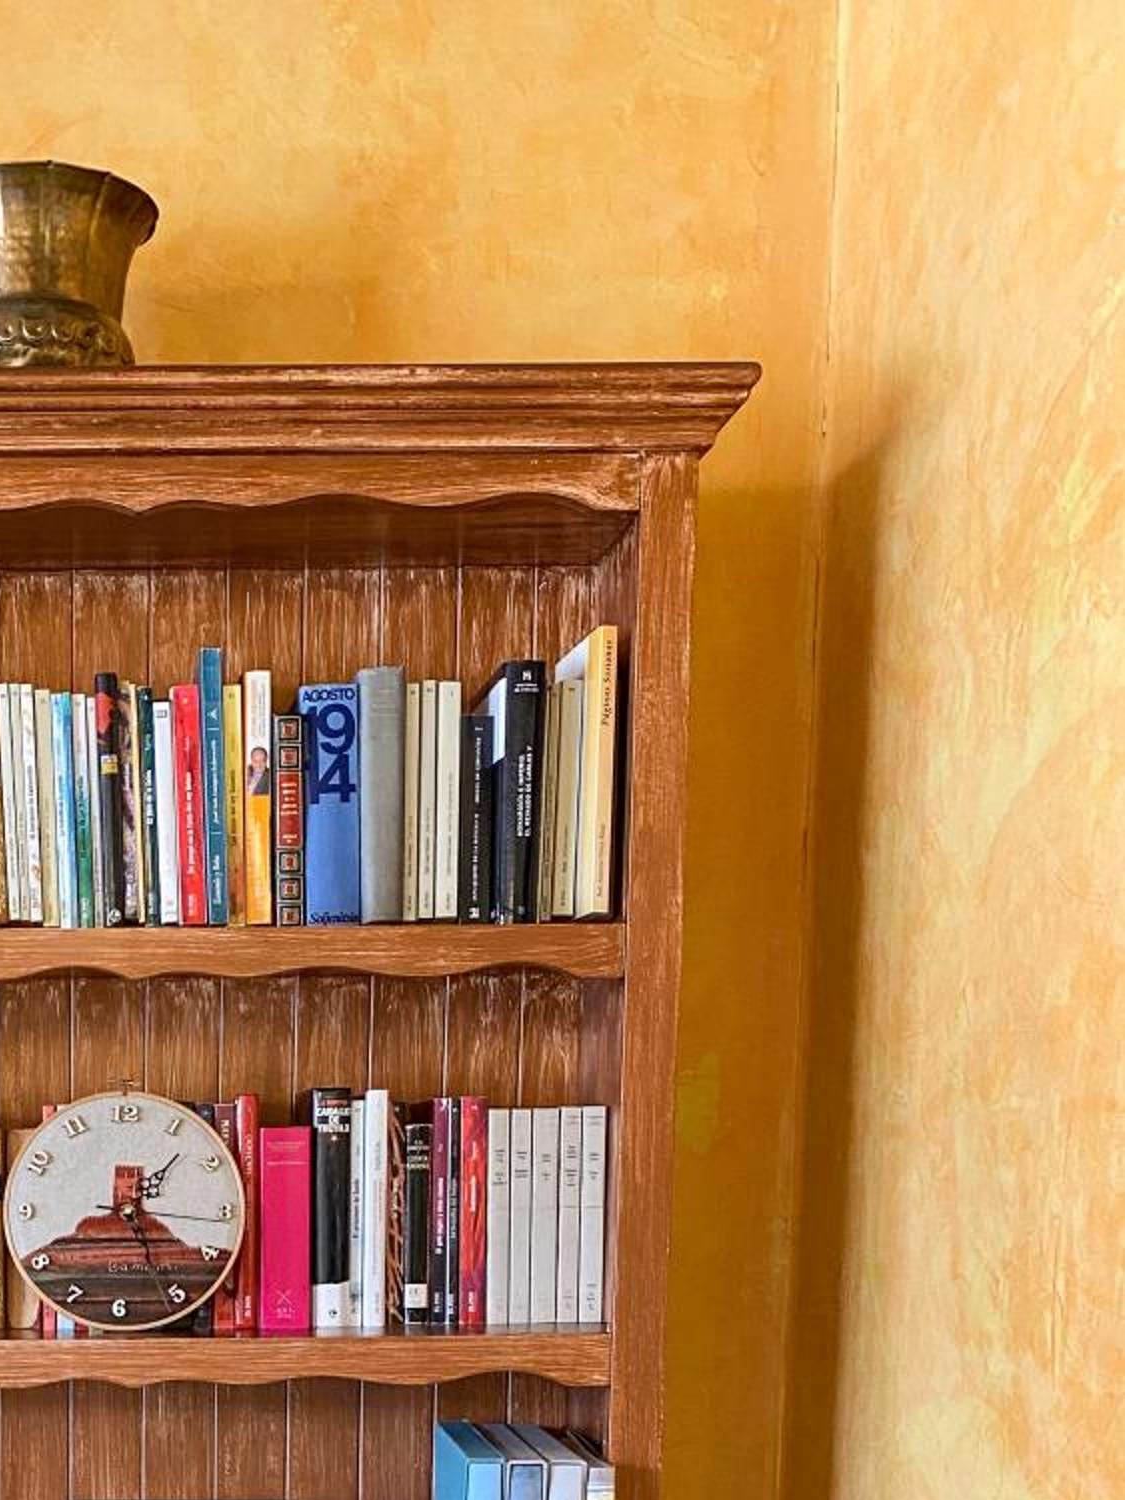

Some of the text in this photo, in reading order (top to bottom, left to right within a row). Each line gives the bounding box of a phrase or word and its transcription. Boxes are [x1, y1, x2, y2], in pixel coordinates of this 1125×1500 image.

[303, 687, 355, 702] AGOSTO
[111, 1105, 139, 1123] 12
[61, 1117, 89, 1138] 11
[165, 1118, 181, 1136] 1
[28, 1149, 52, 1176] 10
[202, 1155, 221, 1172] 2
[19, 1203, 34, 1220] 9
[218, 1203, 233, 1220] 3
[30, 1253, 50, 1270] 8
[200, 1245, 220, 1261] 4
[65, 1285, 84, 1304] 7
[169, 1284, 187, 1303] 5
[112, 1299, 127, 1317] 6
